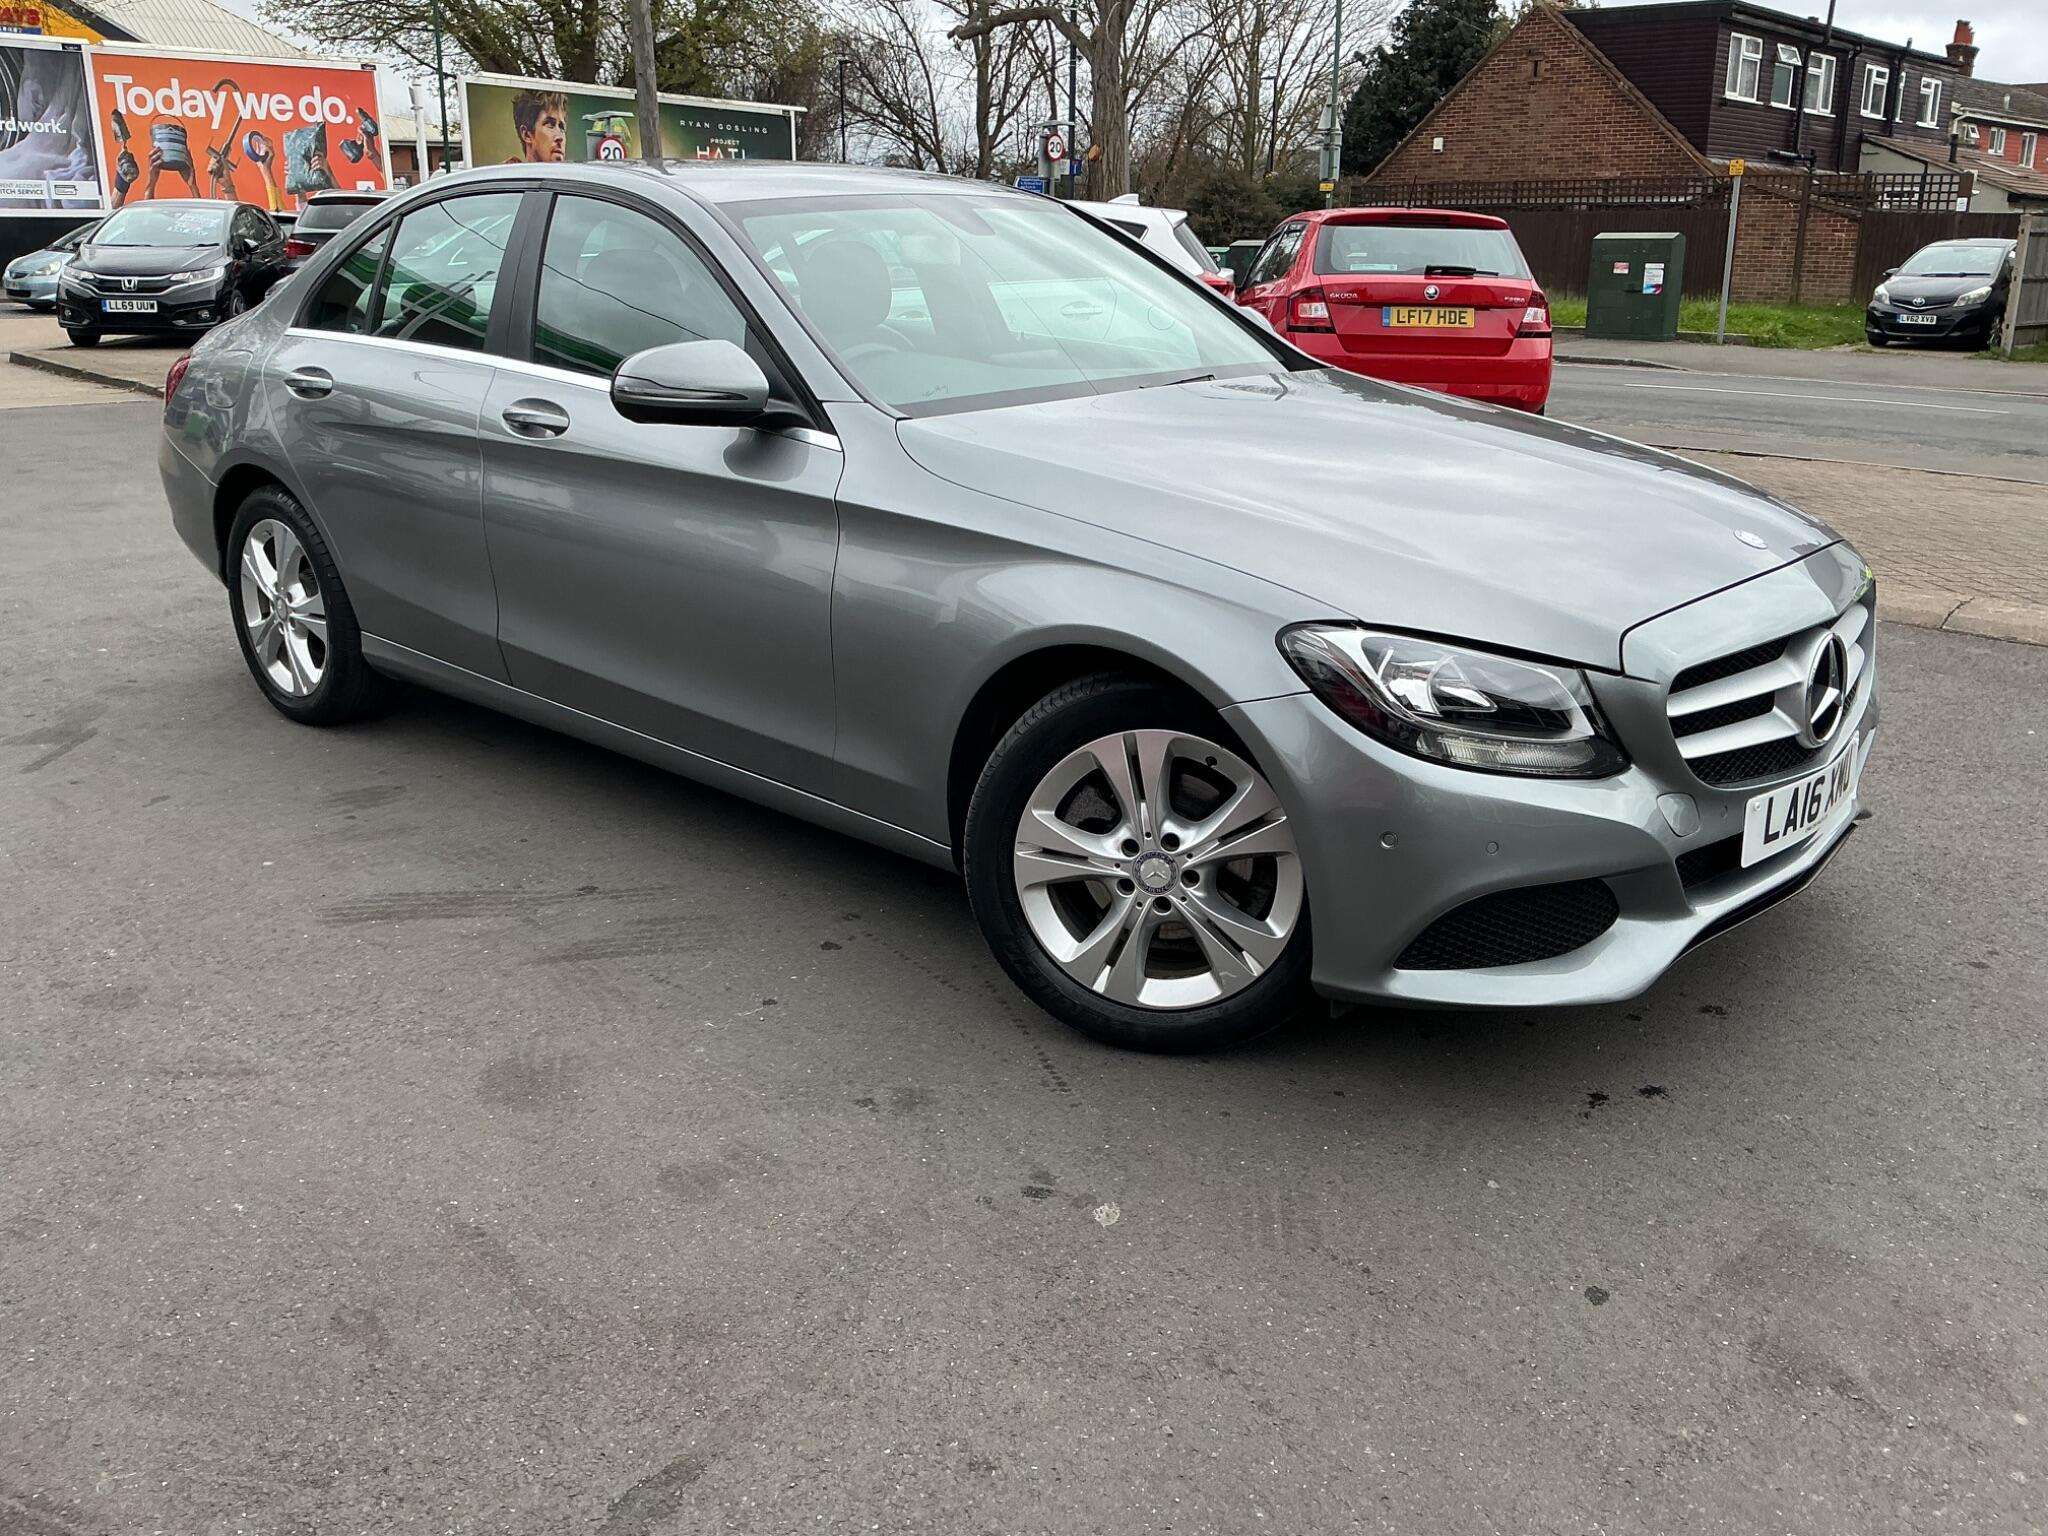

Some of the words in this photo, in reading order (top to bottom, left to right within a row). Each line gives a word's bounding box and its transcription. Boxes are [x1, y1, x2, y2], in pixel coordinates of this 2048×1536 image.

[103, 74, 227, 129] Today
[232, 91, 293, 122] we
[298, 86, 354, 124] do.
[18, 119, 67, 134] work.
[679, 120, 710, 129] RYAN
[717, 123, 768, 134] GOSLING
[710, 137, 740, 145] PROJECT
[1049, 141, 1061, 153] 20
[602, 147, 622, 159] 20
[109, 301, 133, 310] LL69
[1396, 309, 1431, 324] LF17
[1437, 310, 1468, 325] HDE
[1763, 775, 1826, 845] LA16
